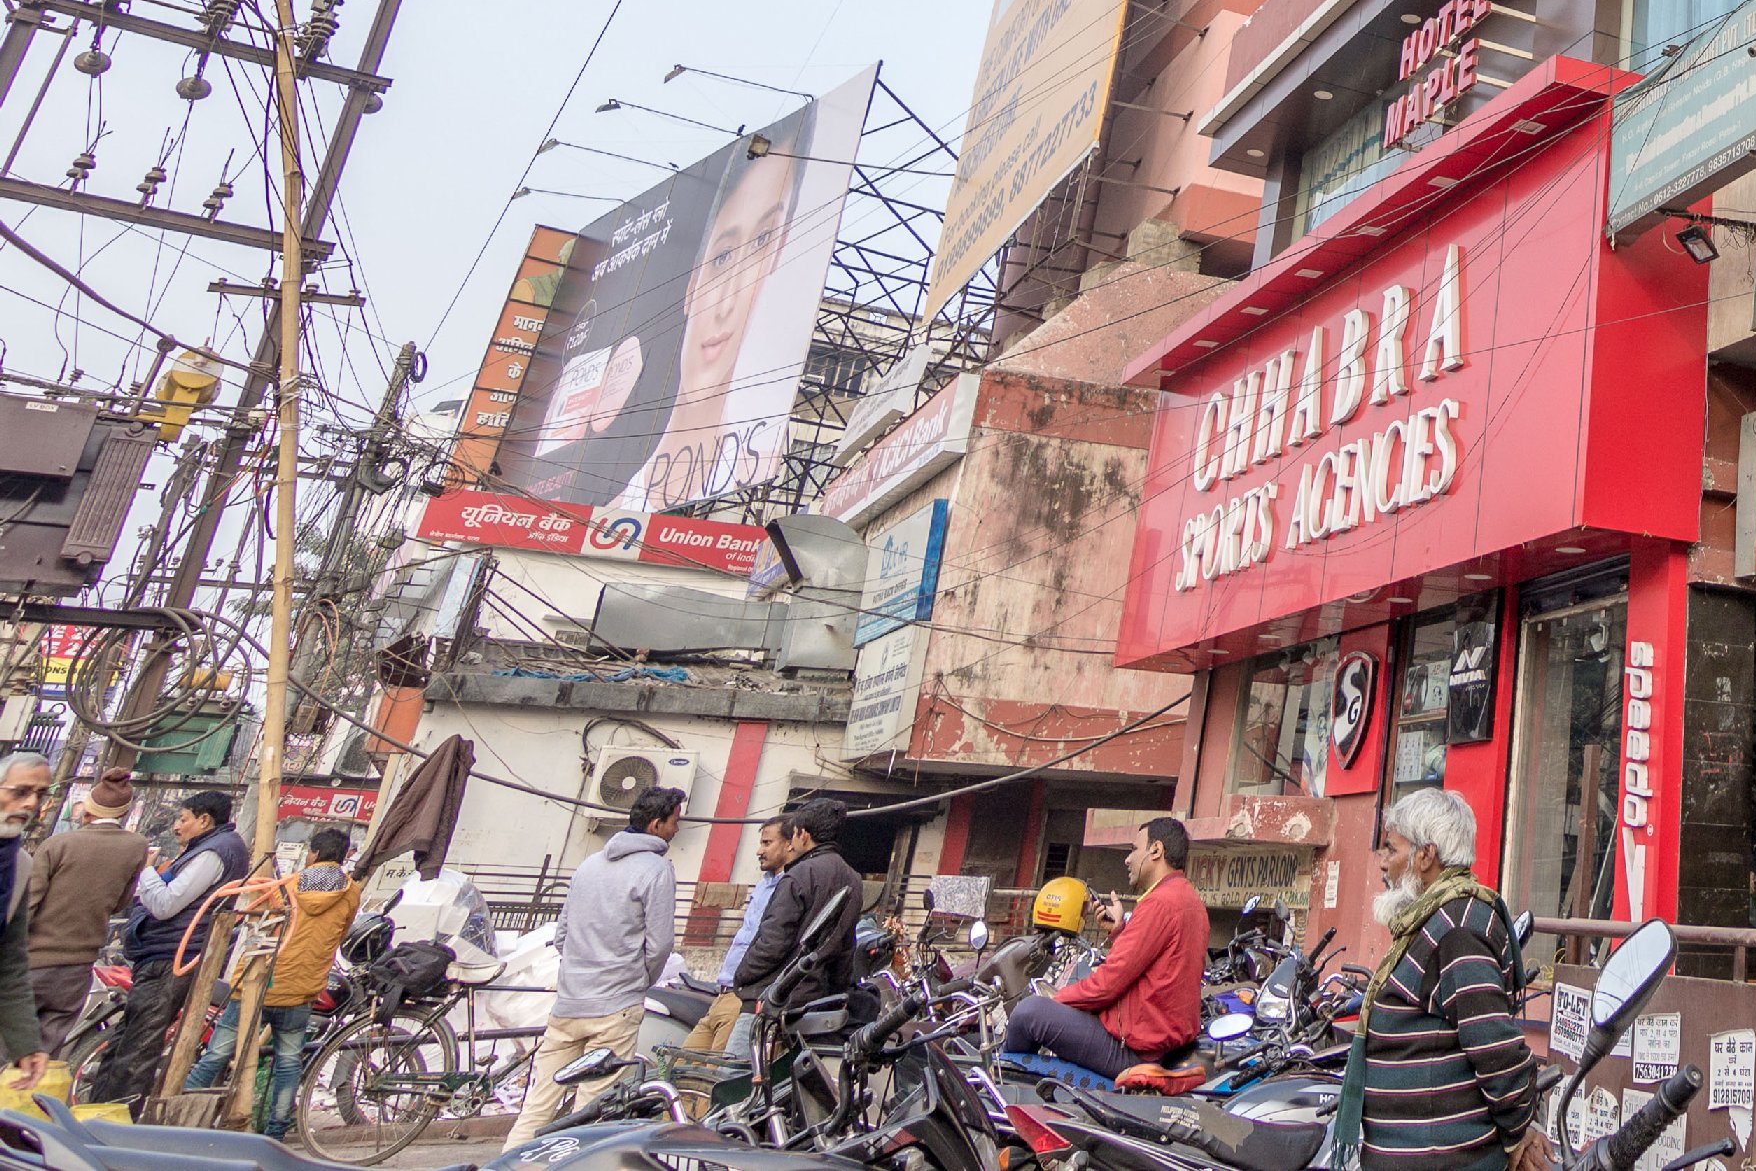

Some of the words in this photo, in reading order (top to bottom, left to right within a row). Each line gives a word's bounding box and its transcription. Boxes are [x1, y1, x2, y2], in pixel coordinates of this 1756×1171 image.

[1383, 38, 1479, 150] MAPLE
[1194, 243, 1466, 492] CHHABRA
[1176, 480, 1281, 592] SPORTS
[1285, 398, 1461, 550] AGENCIES
[658, 526, 713, 548] Union
[715, 533, 761, 553] Bank
[1227, 855, 1257, 888] GENTS
[1255, 853, 1299, 888] PARLOUR
[1556, 990, 1588, 1017] TO-LET
